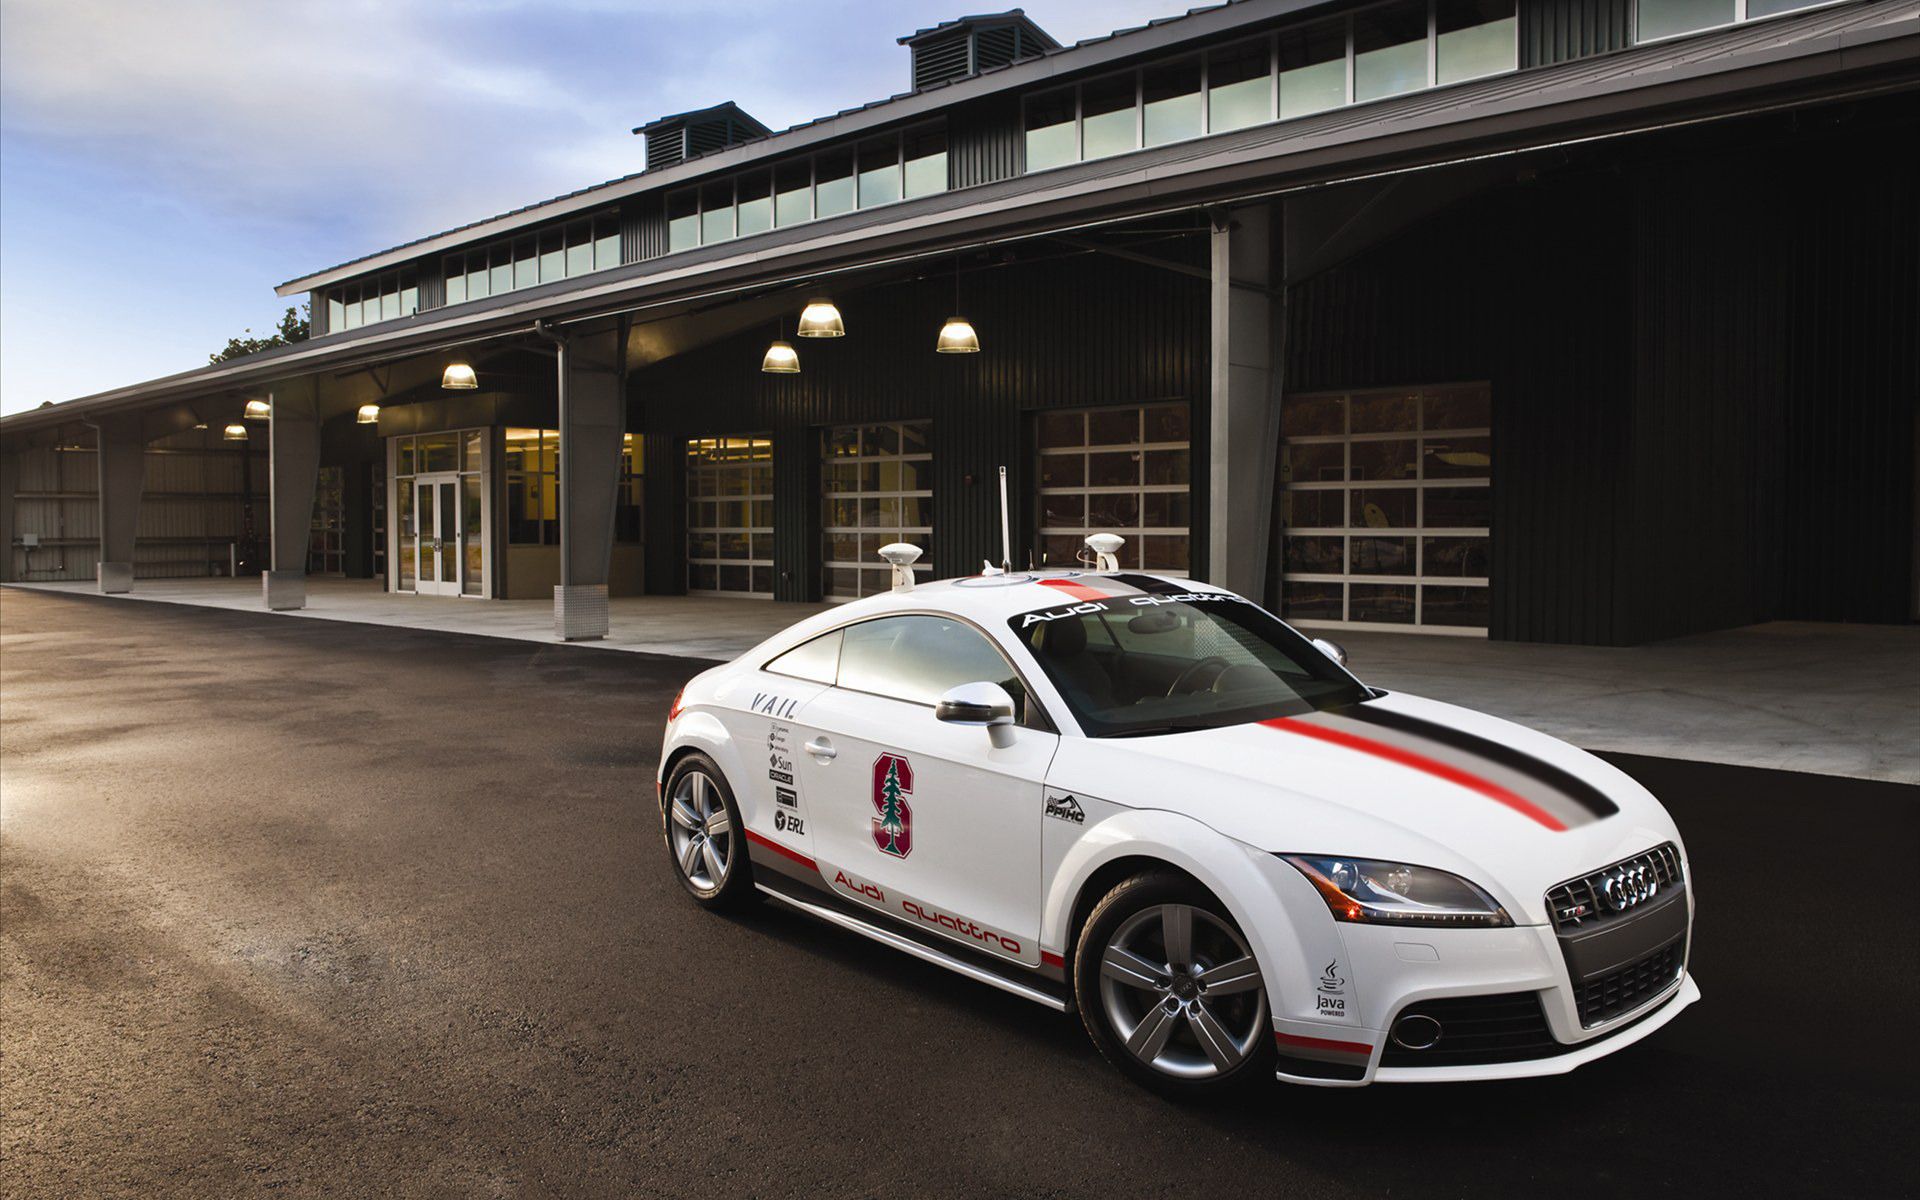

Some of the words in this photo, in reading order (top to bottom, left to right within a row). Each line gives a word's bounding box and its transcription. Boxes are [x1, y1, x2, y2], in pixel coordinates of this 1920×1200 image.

[1021, 602, 1109, 628] Audi
[751, 692, 798, 719] VAIL
[777, 755, 792, 772] Sun
[770, 771, 792, 783] ORACLE
[1045, 805, 1085, 822] PPIHC
[787, 815, 805, 835] ERL
[835, 871, 885, 903] Audi
[902, 900, 1021, 954] quattro
[1315, 994, 1345, 1010] Java
[1320, 1009, 1345, 1017] POWERED
